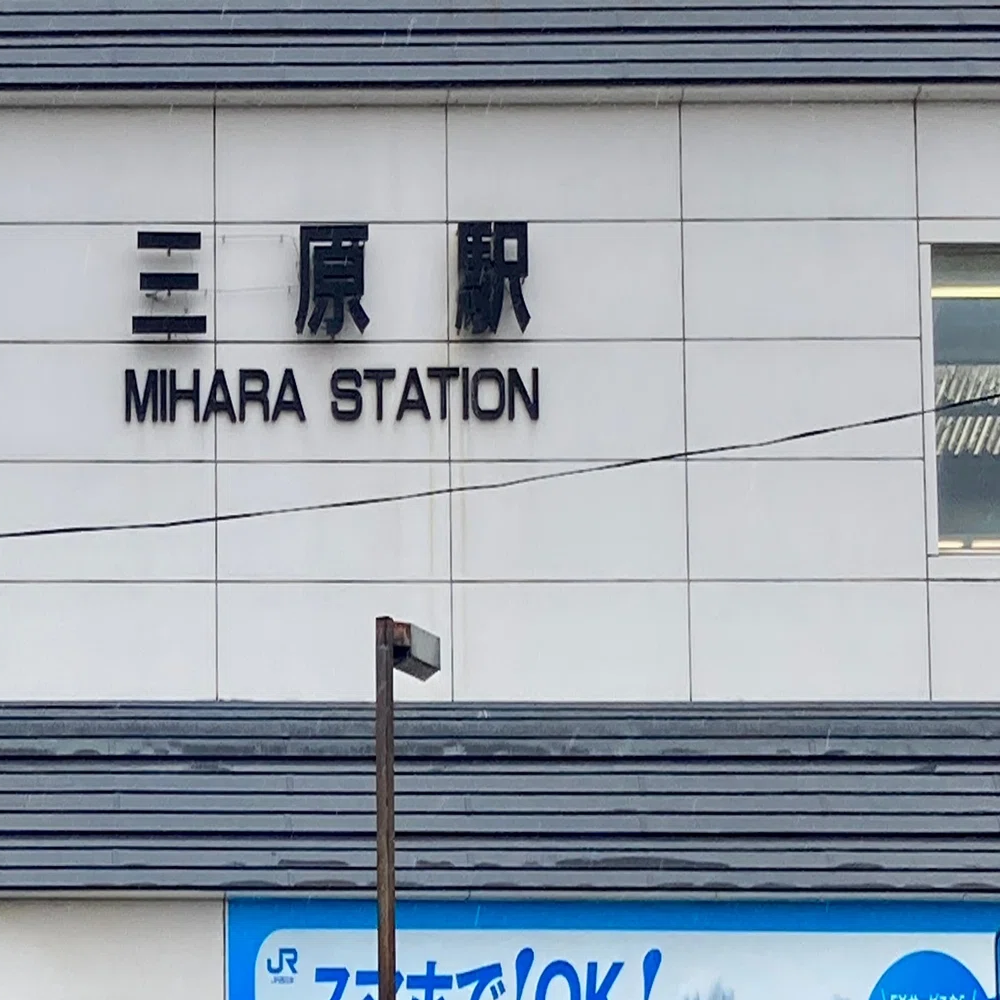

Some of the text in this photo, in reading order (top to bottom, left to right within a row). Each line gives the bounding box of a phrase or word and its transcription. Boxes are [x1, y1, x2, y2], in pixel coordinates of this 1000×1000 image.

[131, 221, 531, 335] 三原駅
[124, 366, 541, 424] MIHARA STATION
[266, 948, 298, 974] JR
